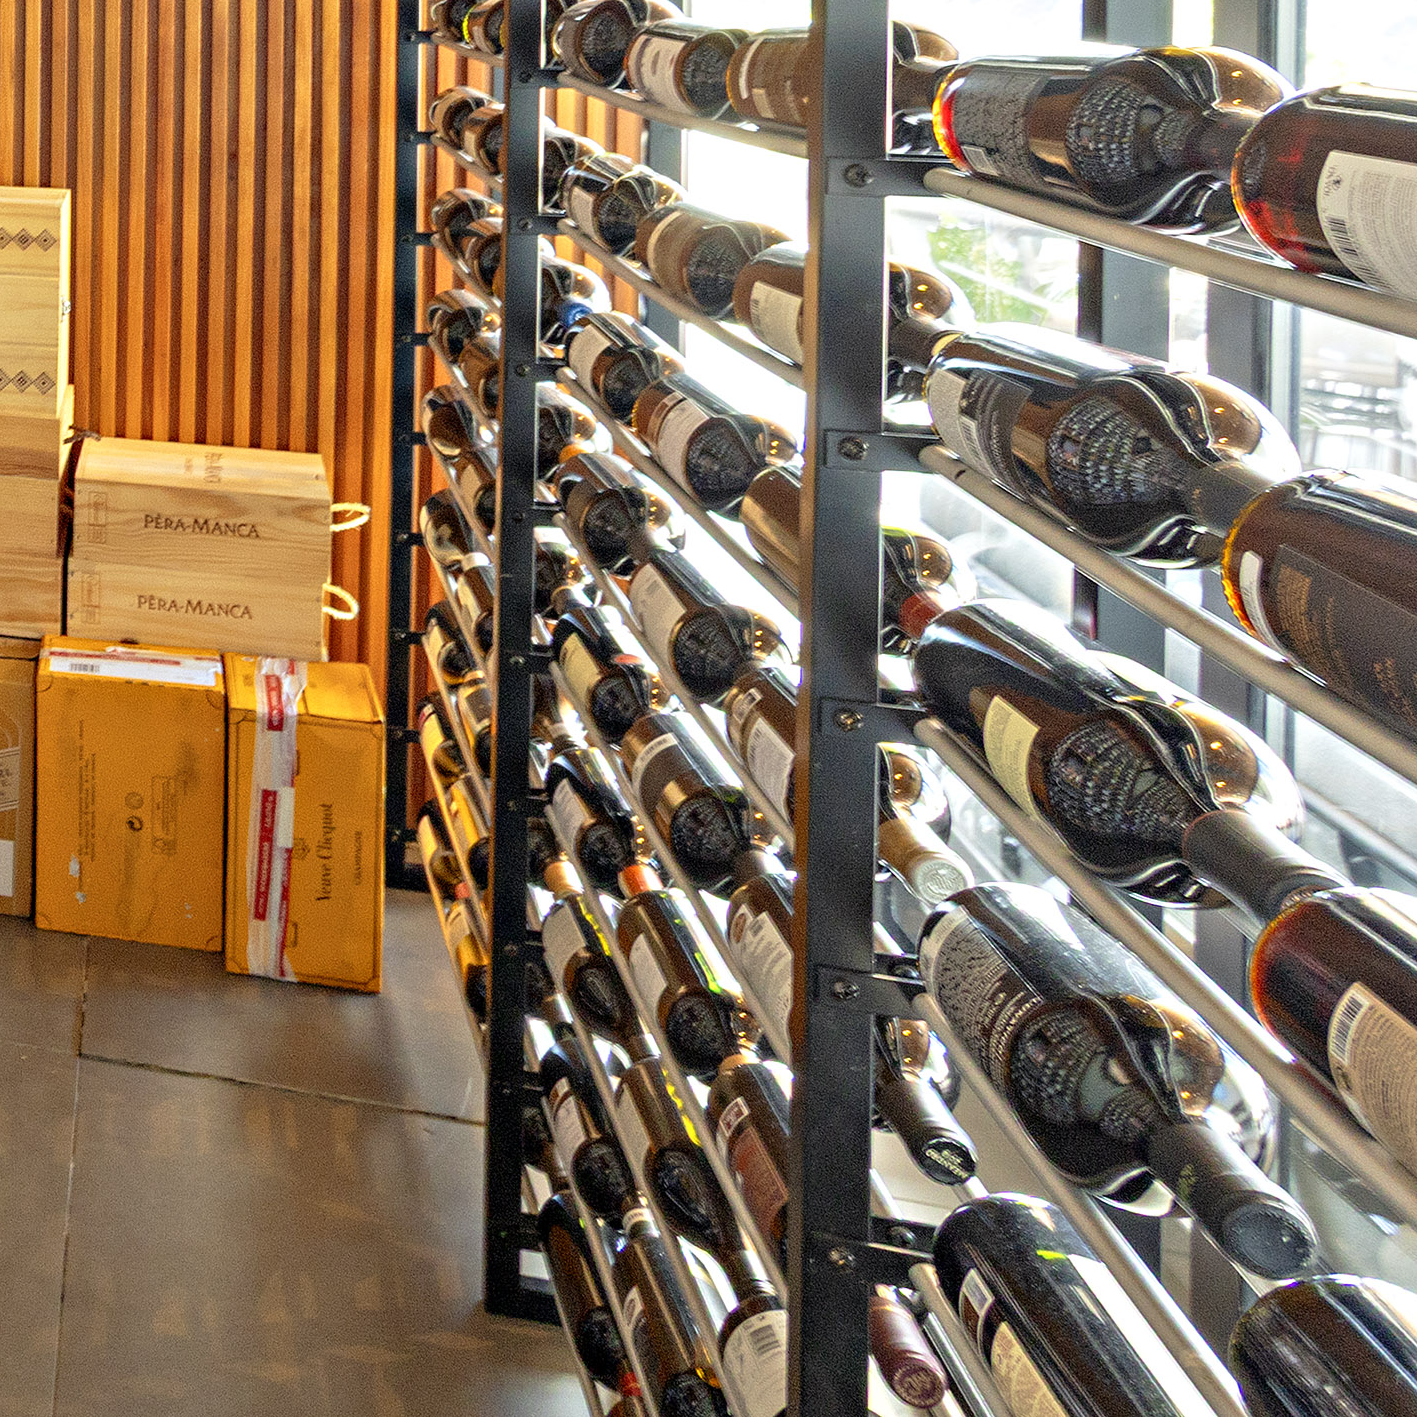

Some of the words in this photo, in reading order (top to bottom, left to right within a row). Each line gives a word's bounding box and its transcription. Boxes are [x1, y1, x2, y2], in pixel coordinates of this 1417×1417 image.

[143, 511, 261, 541] PÊRA-MANCA
[136, 592, 254, 621] PÊRA-MANCA
[314, 801, 337, 857] Clicquot
[314, 859, 336, 904] Veuve
